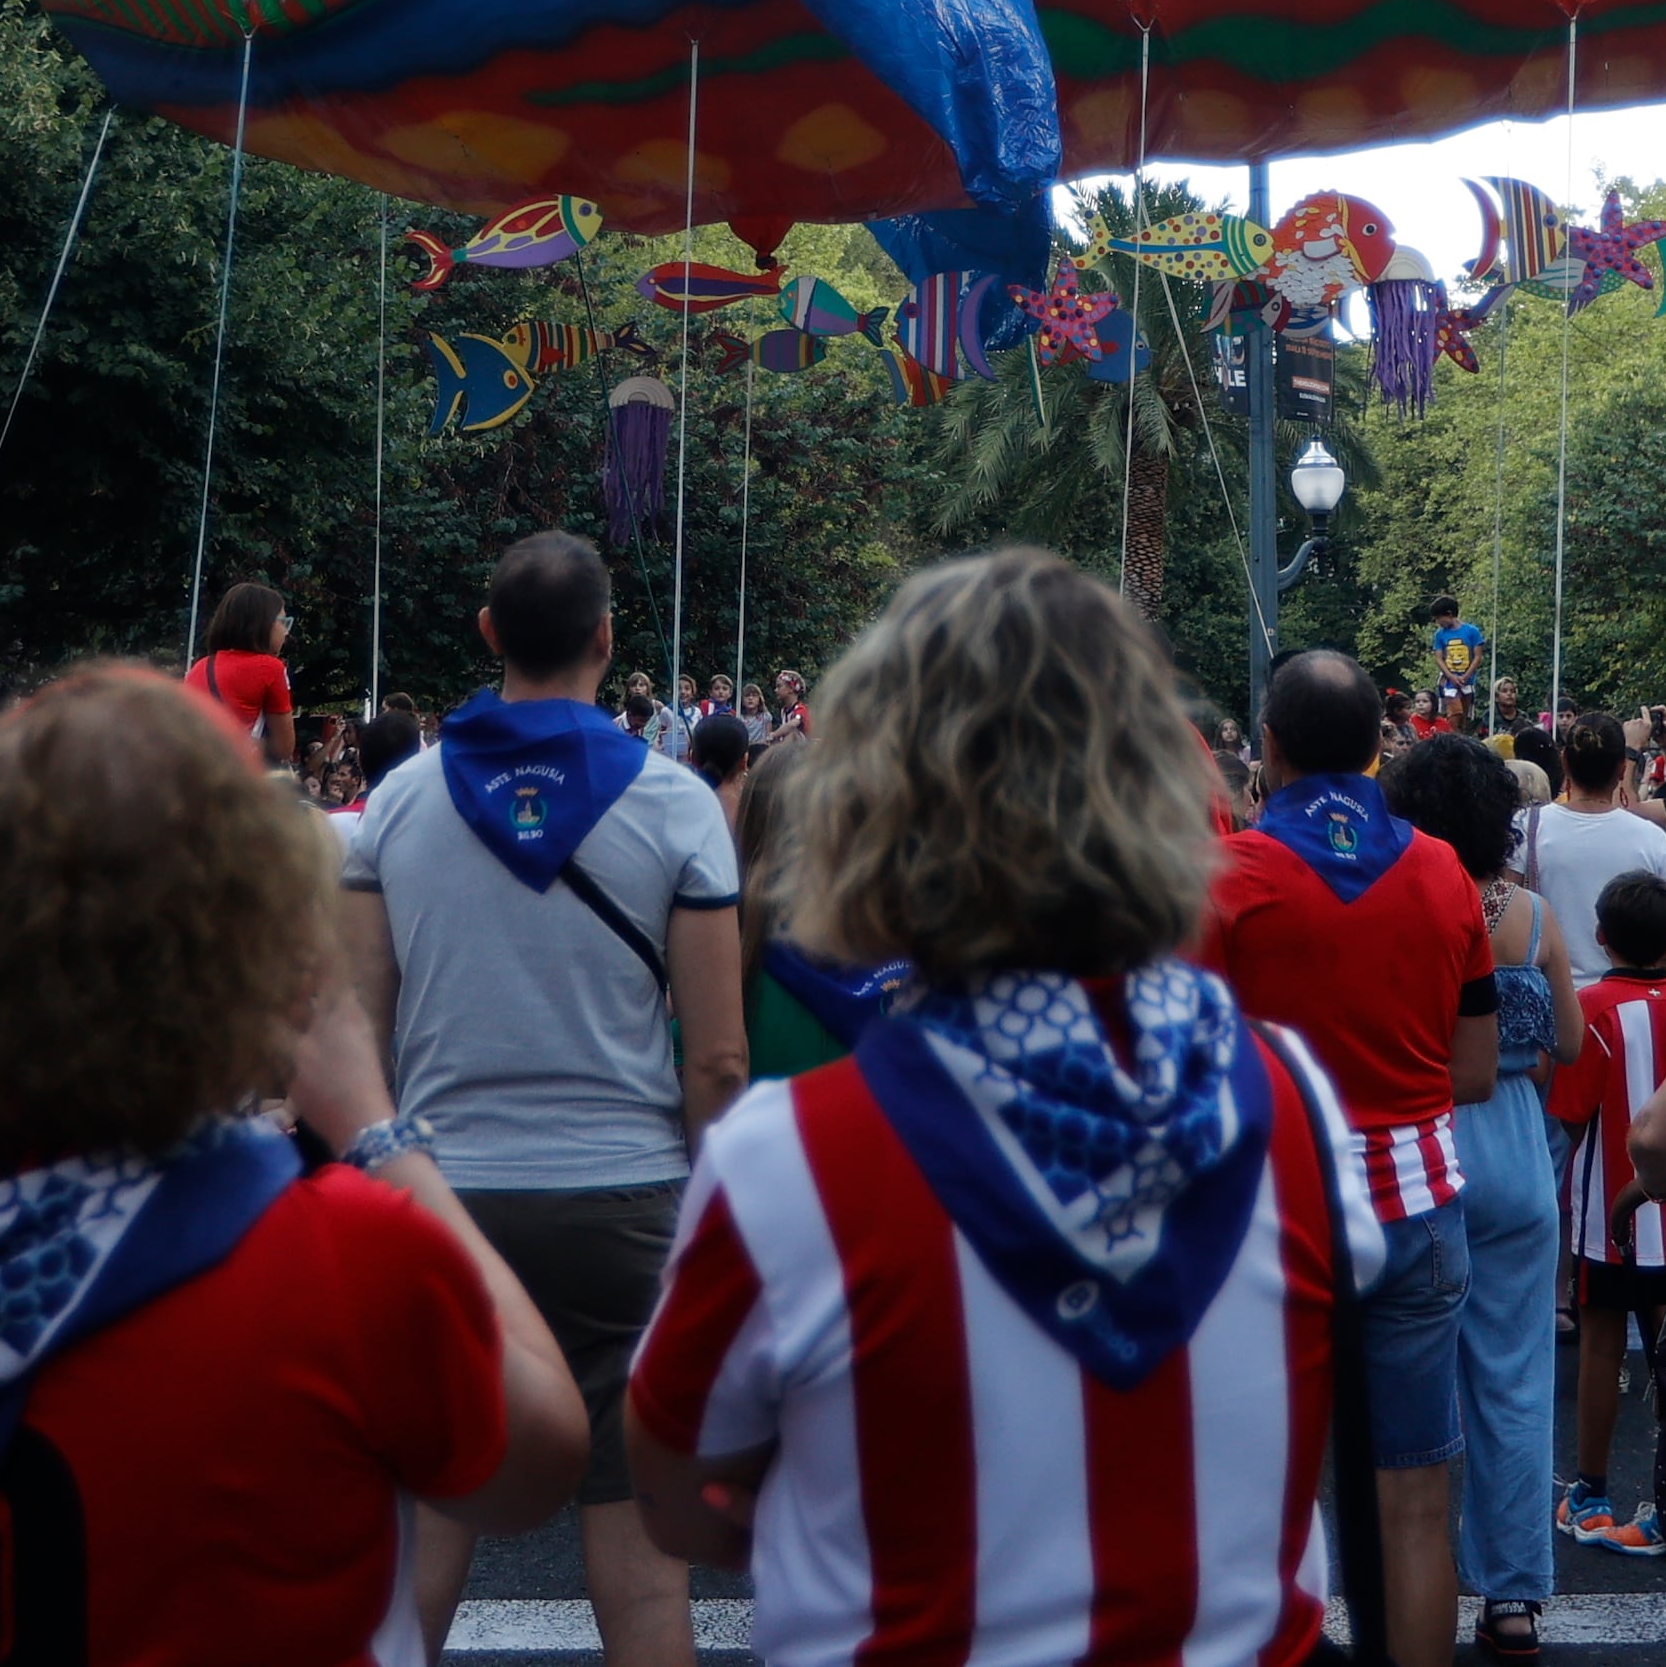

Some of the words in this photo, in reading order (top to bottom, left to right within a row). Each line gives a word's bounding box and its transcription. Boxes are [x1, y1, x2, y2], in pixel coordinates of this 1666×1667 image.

[485, 772, 513, 794] ASTE
[515, 765, 566, 786] NAGUSIA
[1304, 795, 1328, 818] ASTE
